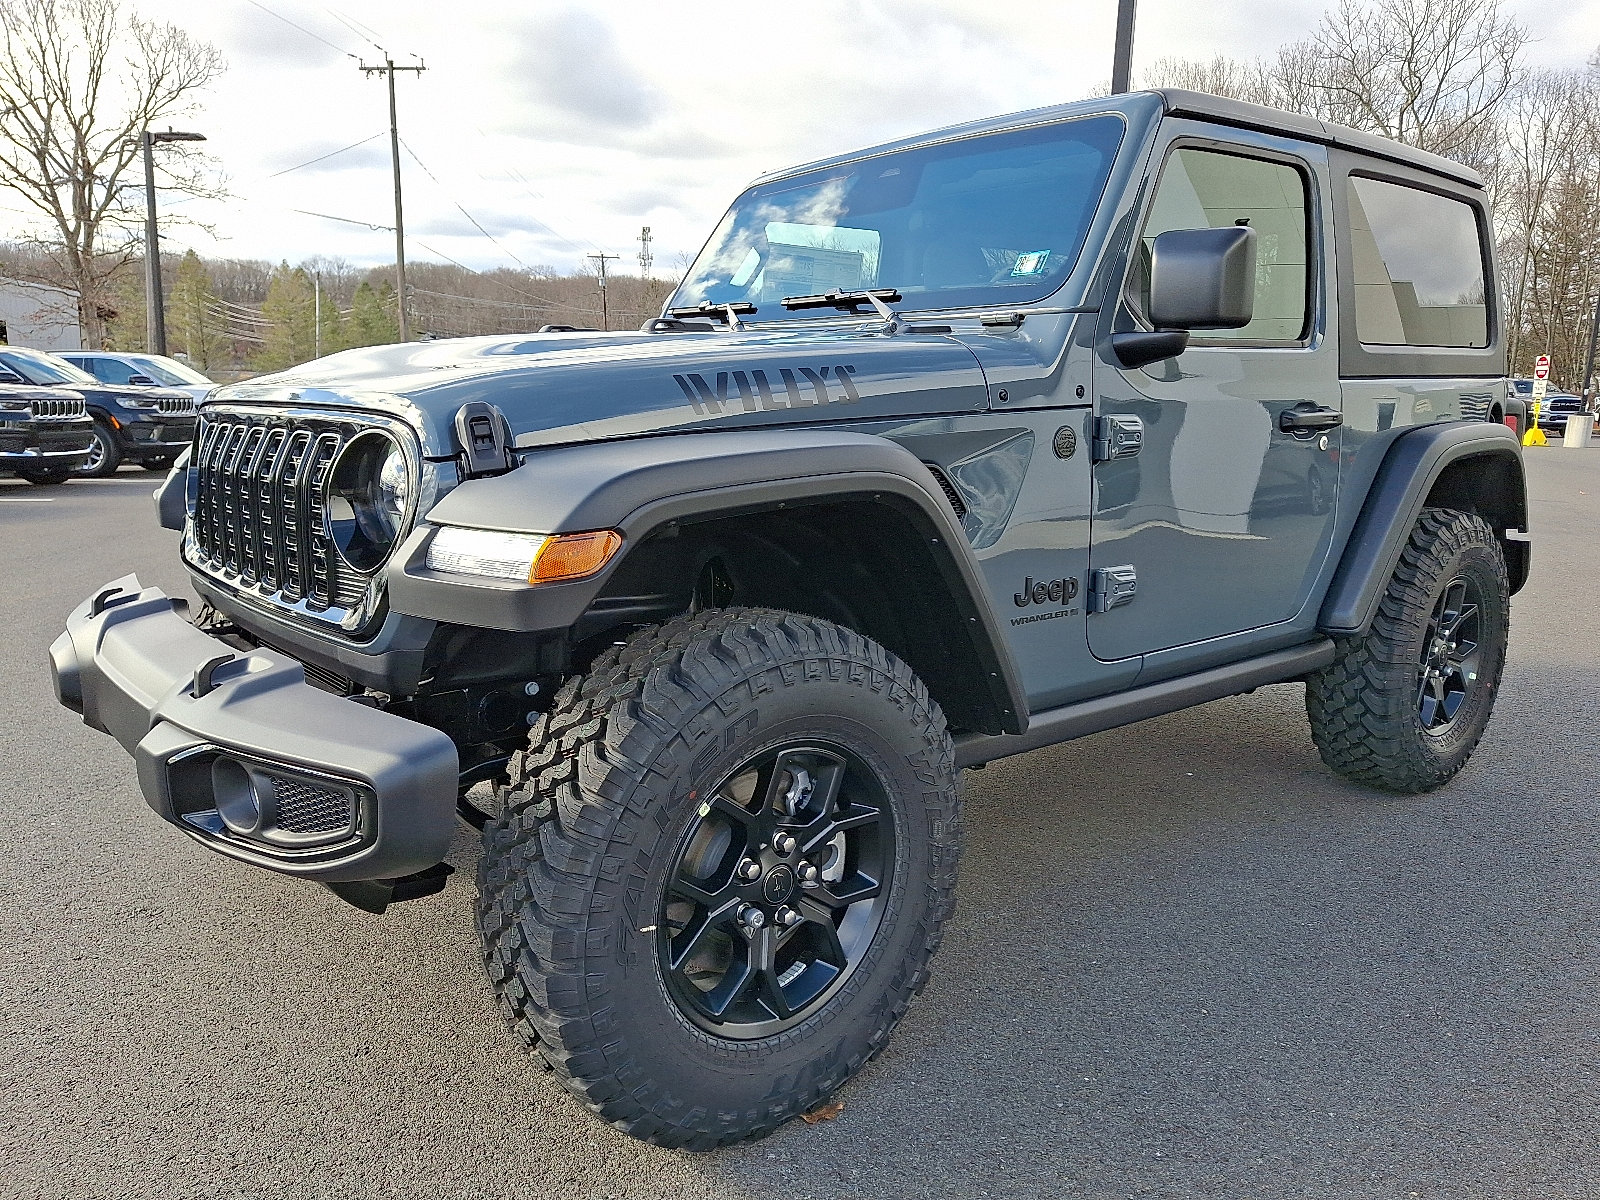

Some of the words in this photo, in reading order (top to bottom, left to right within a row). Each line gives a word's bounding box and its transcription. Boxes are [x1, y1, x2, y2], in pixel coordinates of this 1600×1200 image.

[673, 365, 860, 415] WILLYS
[1013, 575, 1079, 607] Jeep
[1010, 609, 1069, 626] WRANGLER
